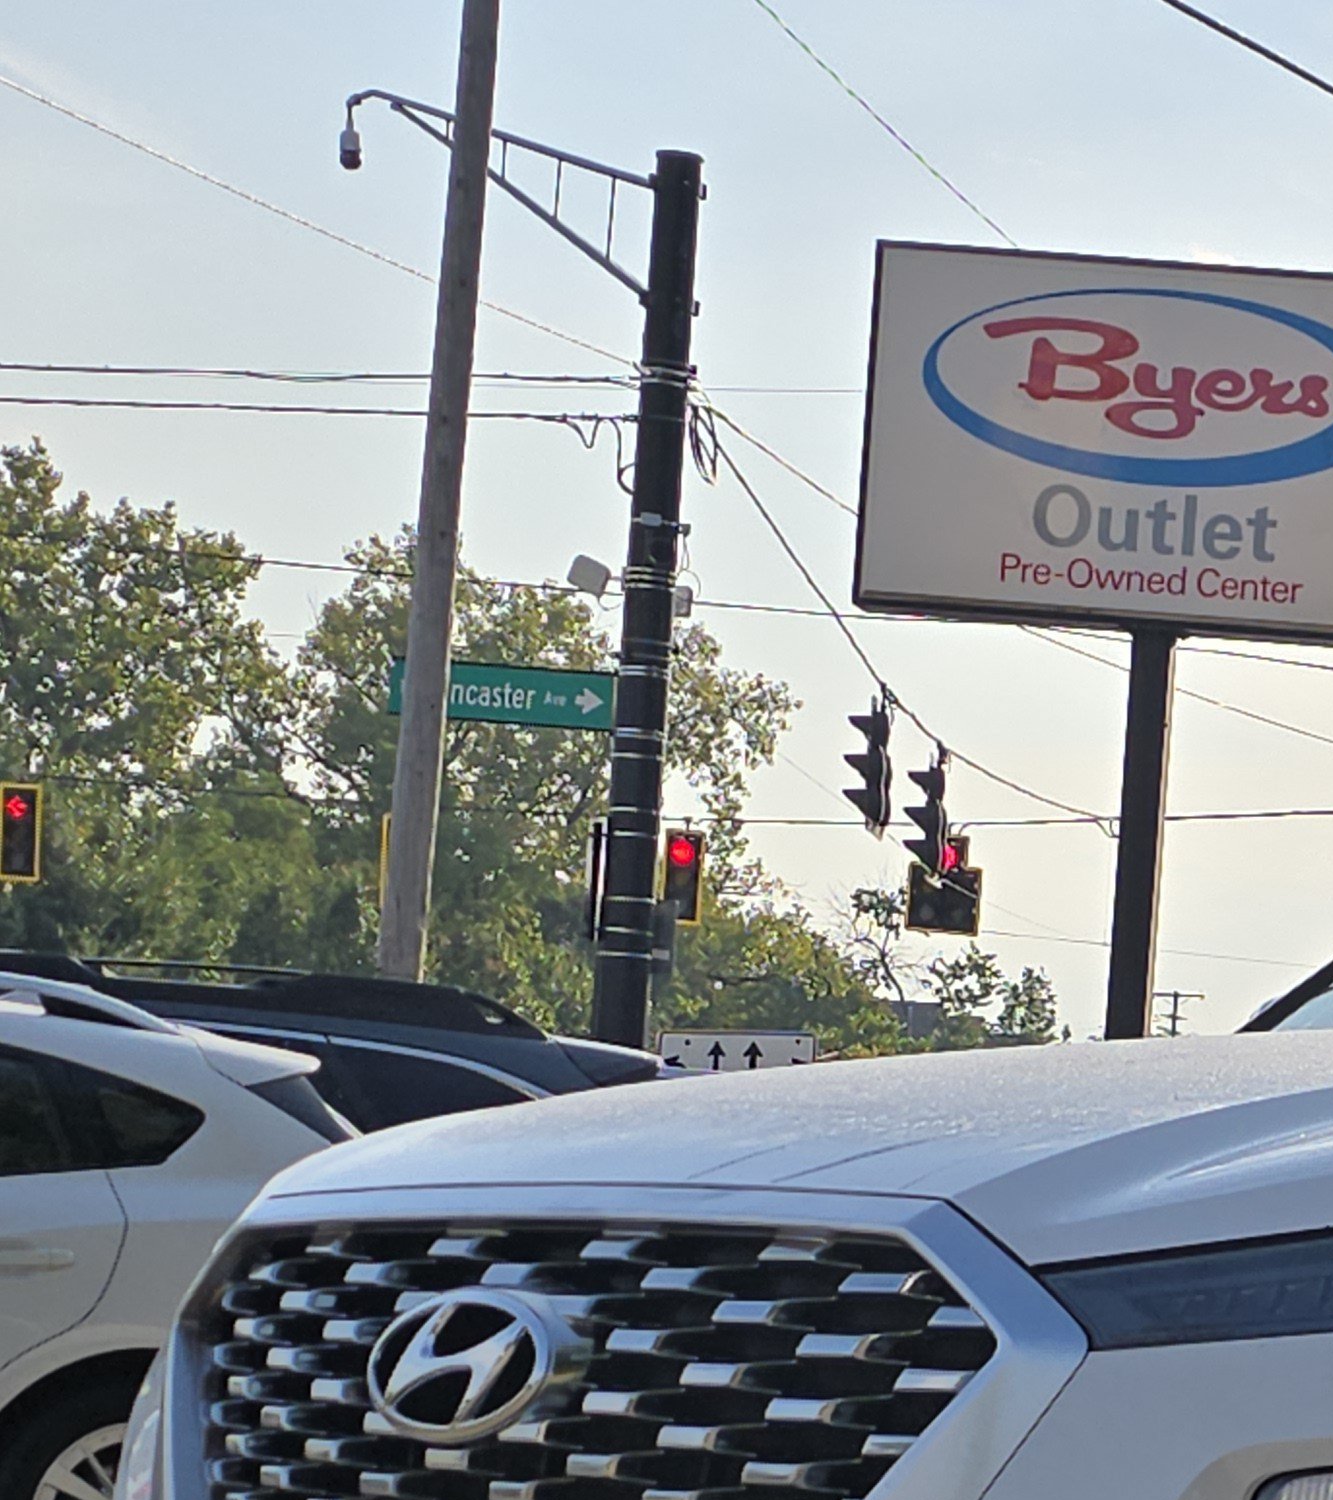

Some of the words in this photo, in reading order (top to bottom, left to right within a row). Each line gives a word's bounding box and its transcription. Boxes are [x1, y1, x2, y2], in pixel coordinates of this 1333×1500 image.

[984, 316, 1330, 440] Byers
[1031, 483, 1278, 565] Outlet
[999, 551, 1188, 596] Pre-Owned
[1195, 566, 1304, 604] Center
[450, 682, 536, 710] ncaster
